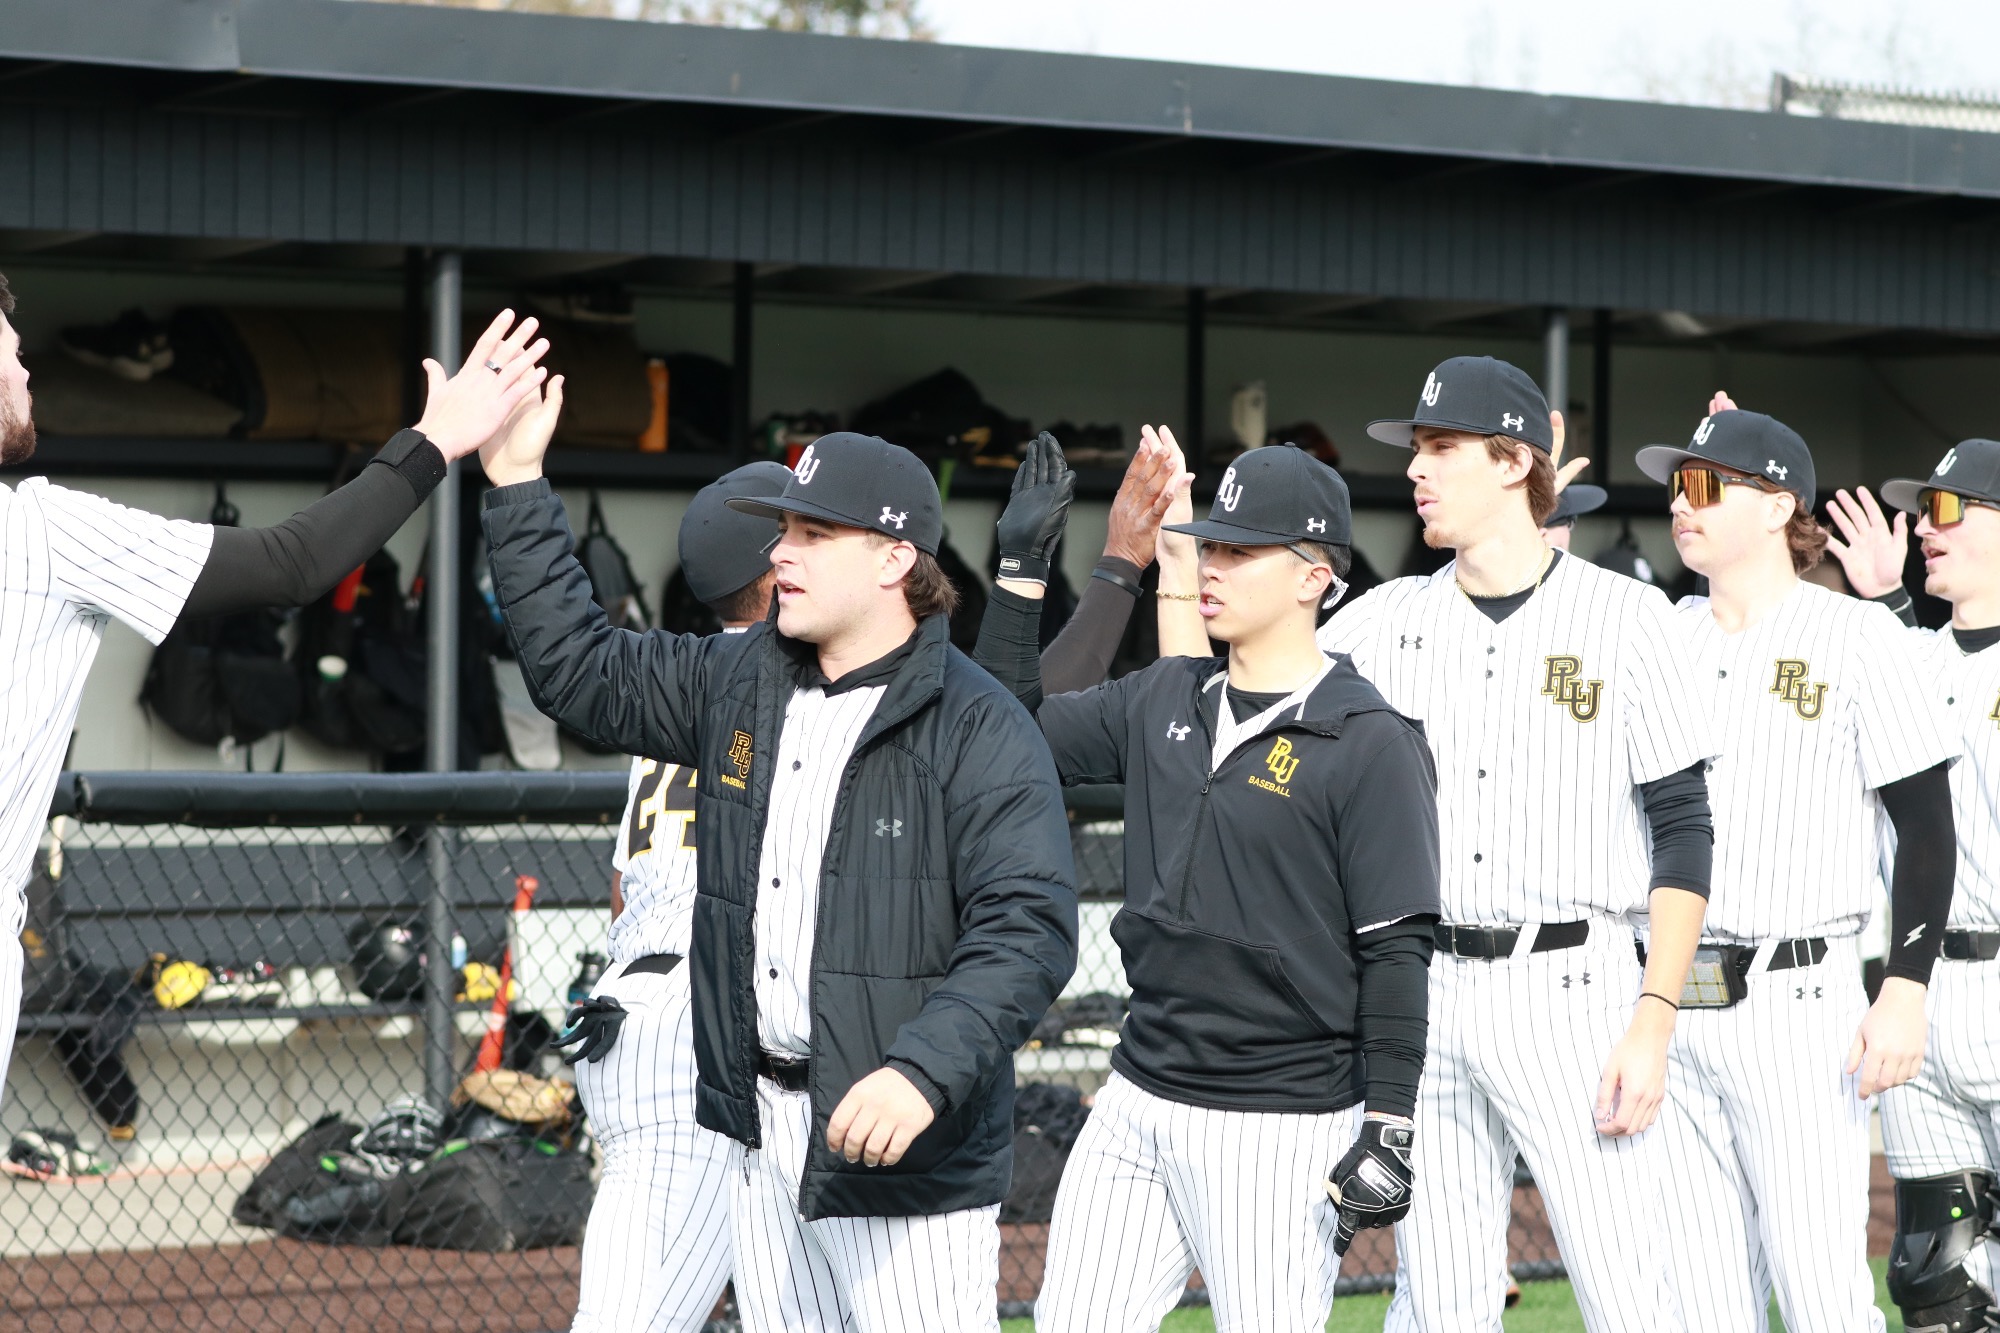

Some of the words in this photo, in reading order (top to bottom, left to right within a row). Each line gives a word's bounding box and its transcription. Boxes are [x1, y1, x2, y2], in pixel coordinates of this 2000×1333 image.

[1541, 654, 1604, 723] PLU
[1768, 658, 1829, 721] PLU
[721, 773, 747, 790] BASEBAL
[1265, 735, 1300, 784] PLU
[1247, 775, 1291, 798] BASEBALL
